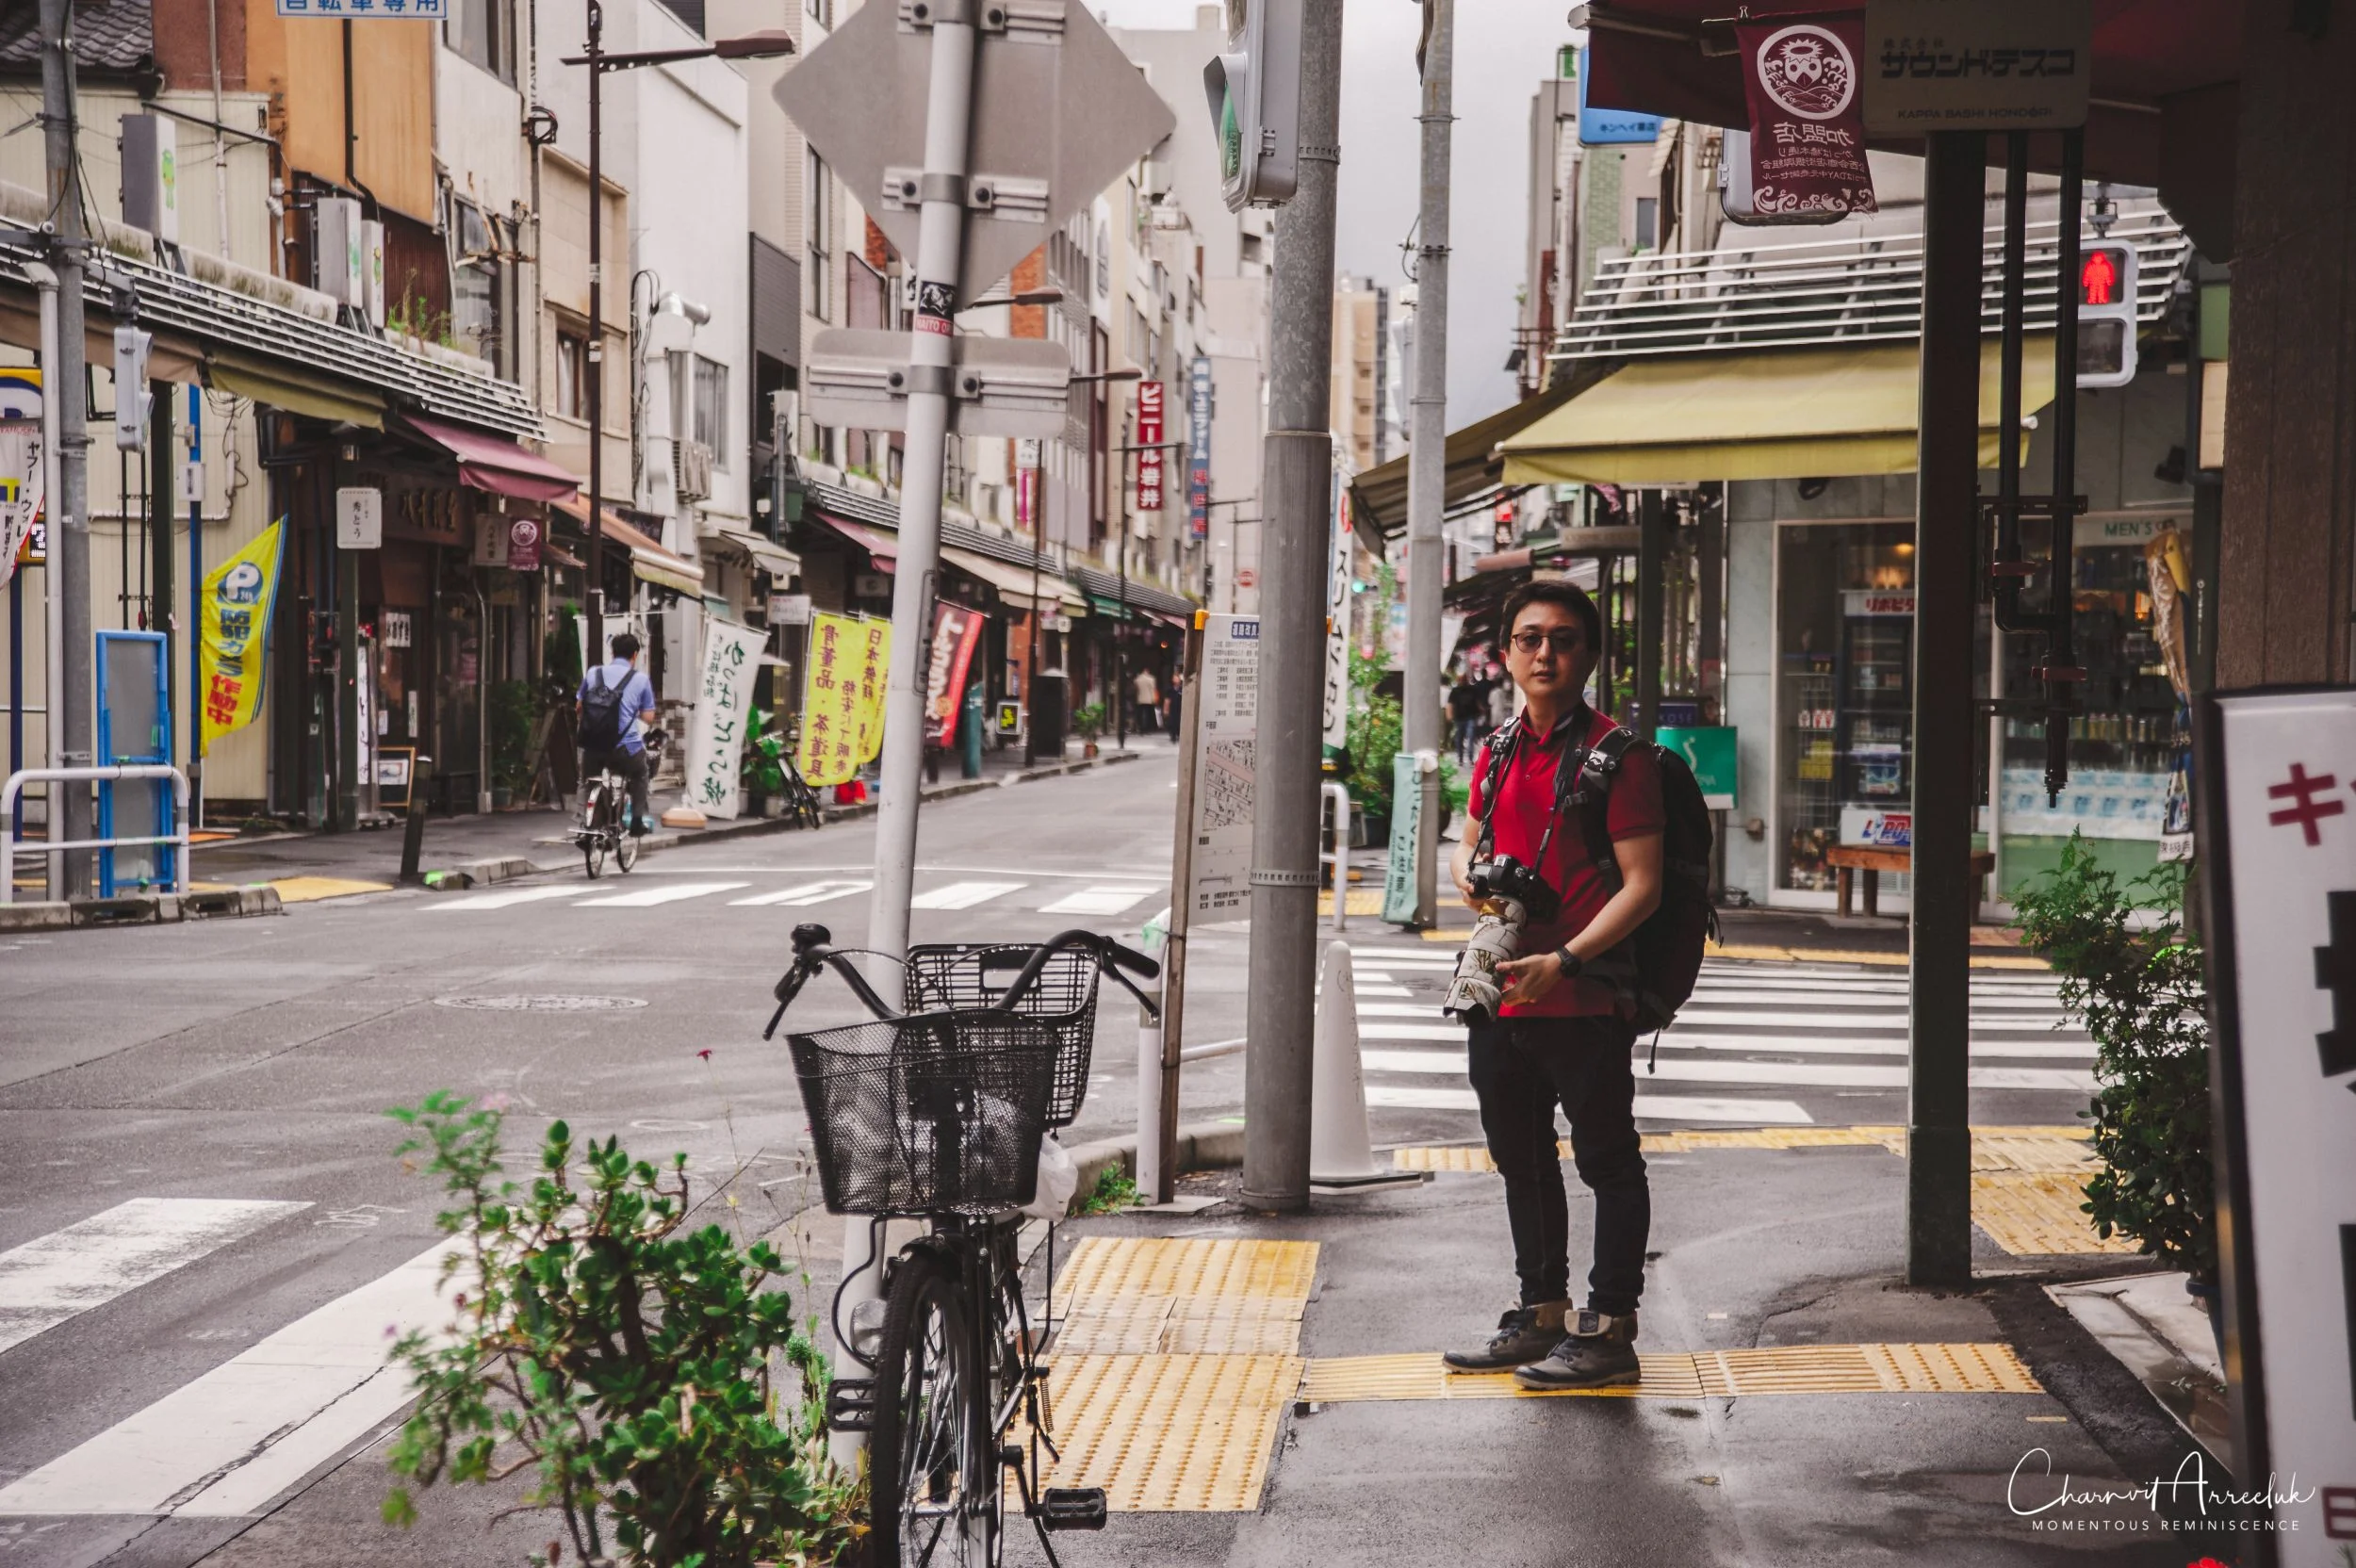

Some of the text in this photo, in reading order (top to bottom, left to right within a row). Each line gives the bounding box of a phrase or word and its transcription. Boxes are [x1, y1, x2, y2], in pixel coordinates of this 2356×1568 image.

[1897, 107, 1940, 120] KAPPA
[1944, 106, 1986, 119] BASHI
[2104, 520, 2152, 537] MEN'S
[225, 565, 259, 600] P
